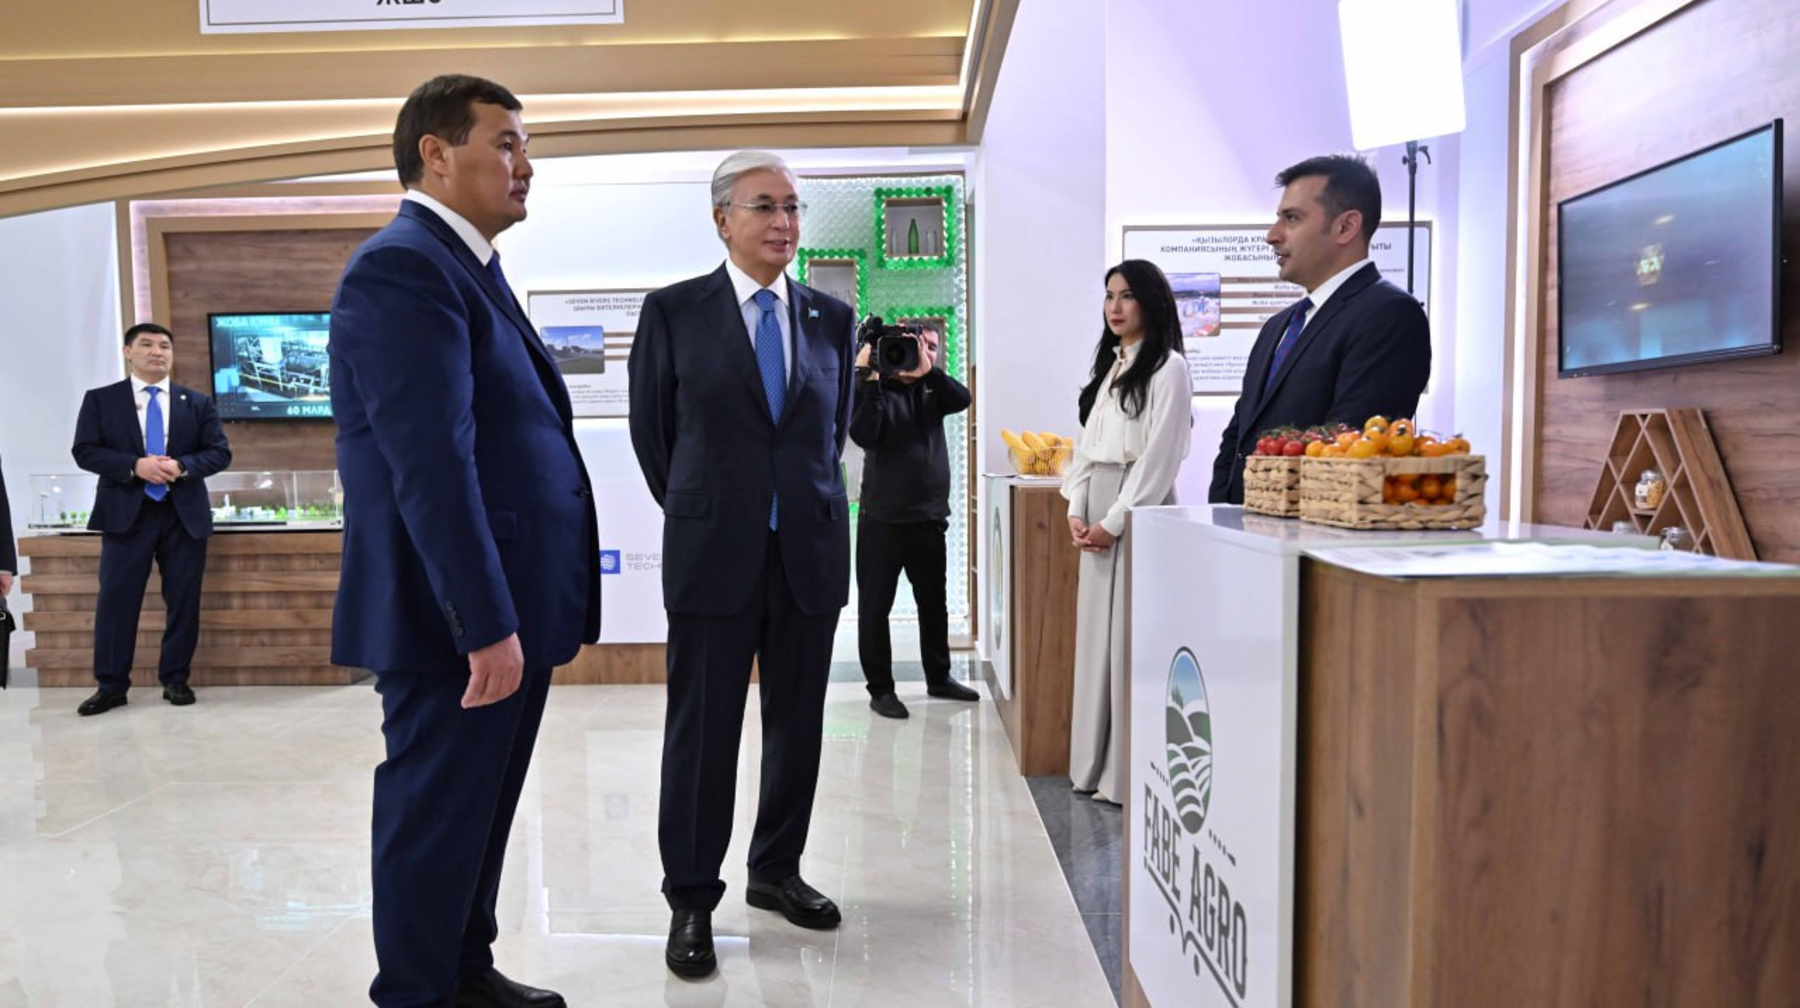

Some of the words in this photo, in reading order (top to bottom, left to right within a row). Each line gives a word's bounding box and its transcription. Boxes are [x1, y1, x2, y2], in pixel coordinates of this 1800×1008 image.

[1160, 245, 1238, 254] КОМПАНИЯСЫНЫҢ
[215, 316, 248, 328] ЖОБА
[287, 405, 300, 416] 60
[1143, 781, 1182, 903] FABE
[1188, 843, 1248, 1000] AGRO
